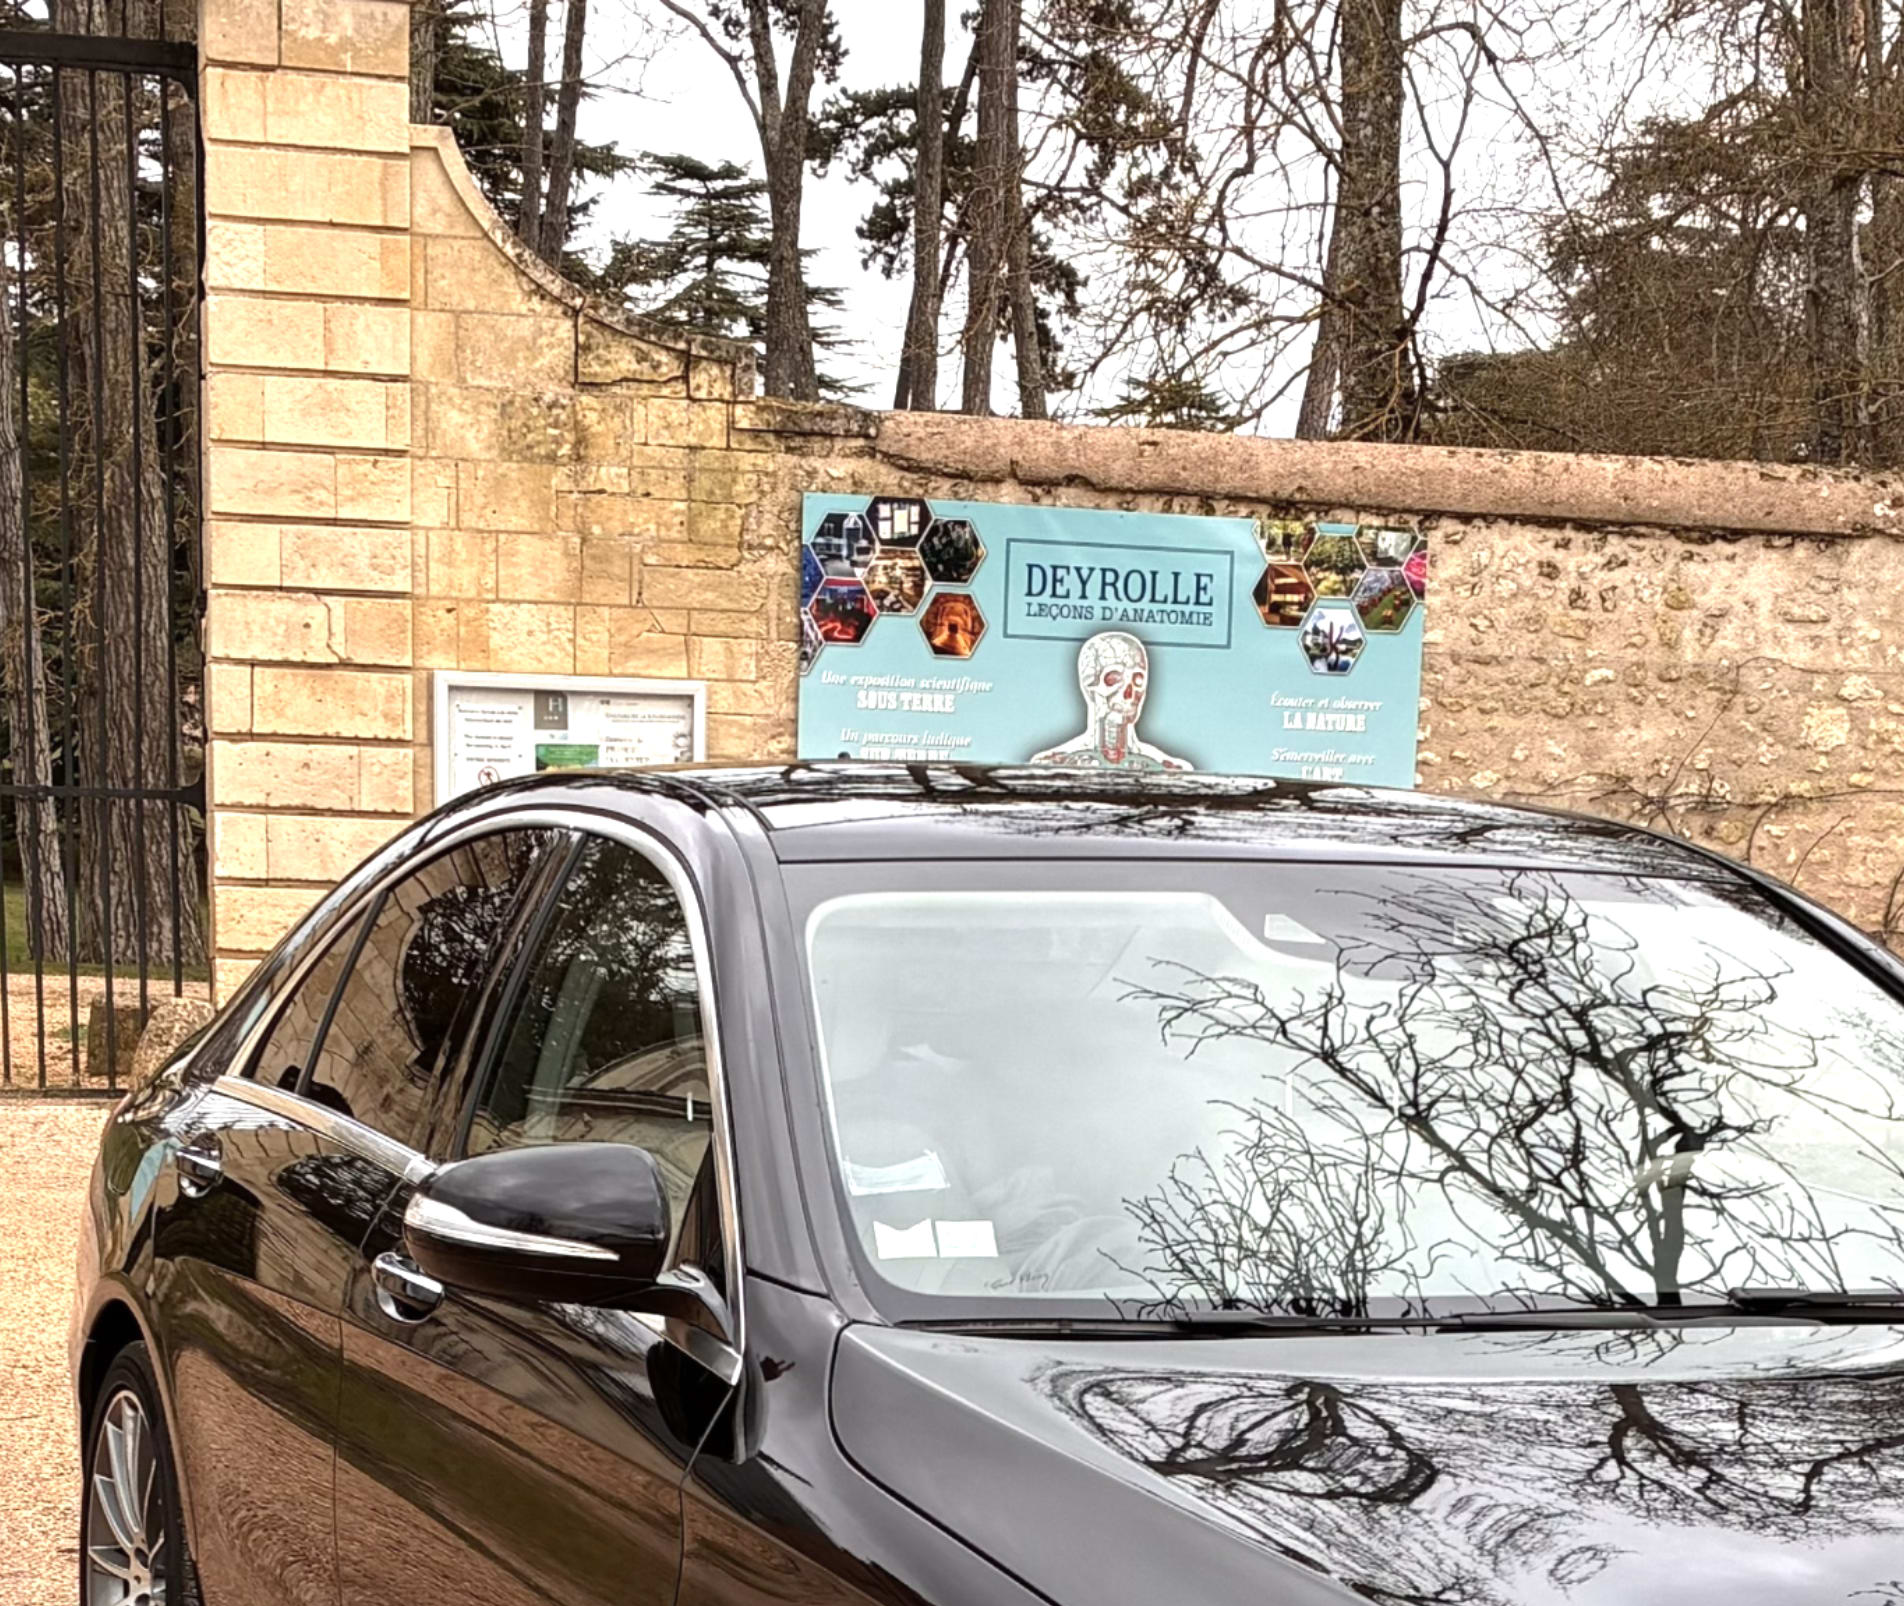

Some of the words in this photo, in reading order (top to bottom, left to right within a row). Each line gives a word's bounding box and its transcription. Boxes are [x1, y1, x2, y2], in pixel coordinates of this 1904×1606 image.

[1024, 563, 1214, 606] DEYROLLE
[1025, 602, 1095, 621] LEÇONS
[1100, 606, 1213, 627] D'ANATOMIE
[821, 670, 847, 685] Une
[849, 674, 916, 690] exposition
[919, 676, 993, 694] scientifique
[857, 690, 897, 710] SOUS
[899, 692, 956, 713] TERRE
[1332, 696, 1384, 711] observer
[1283, 711, 1303, 729] LA
[1306, 712, 1367, 732] NATURE
[839, 728, 859, 742] Un
[861, 732, 919, 746] parcours
[921, 729, 972, 748] ludique
